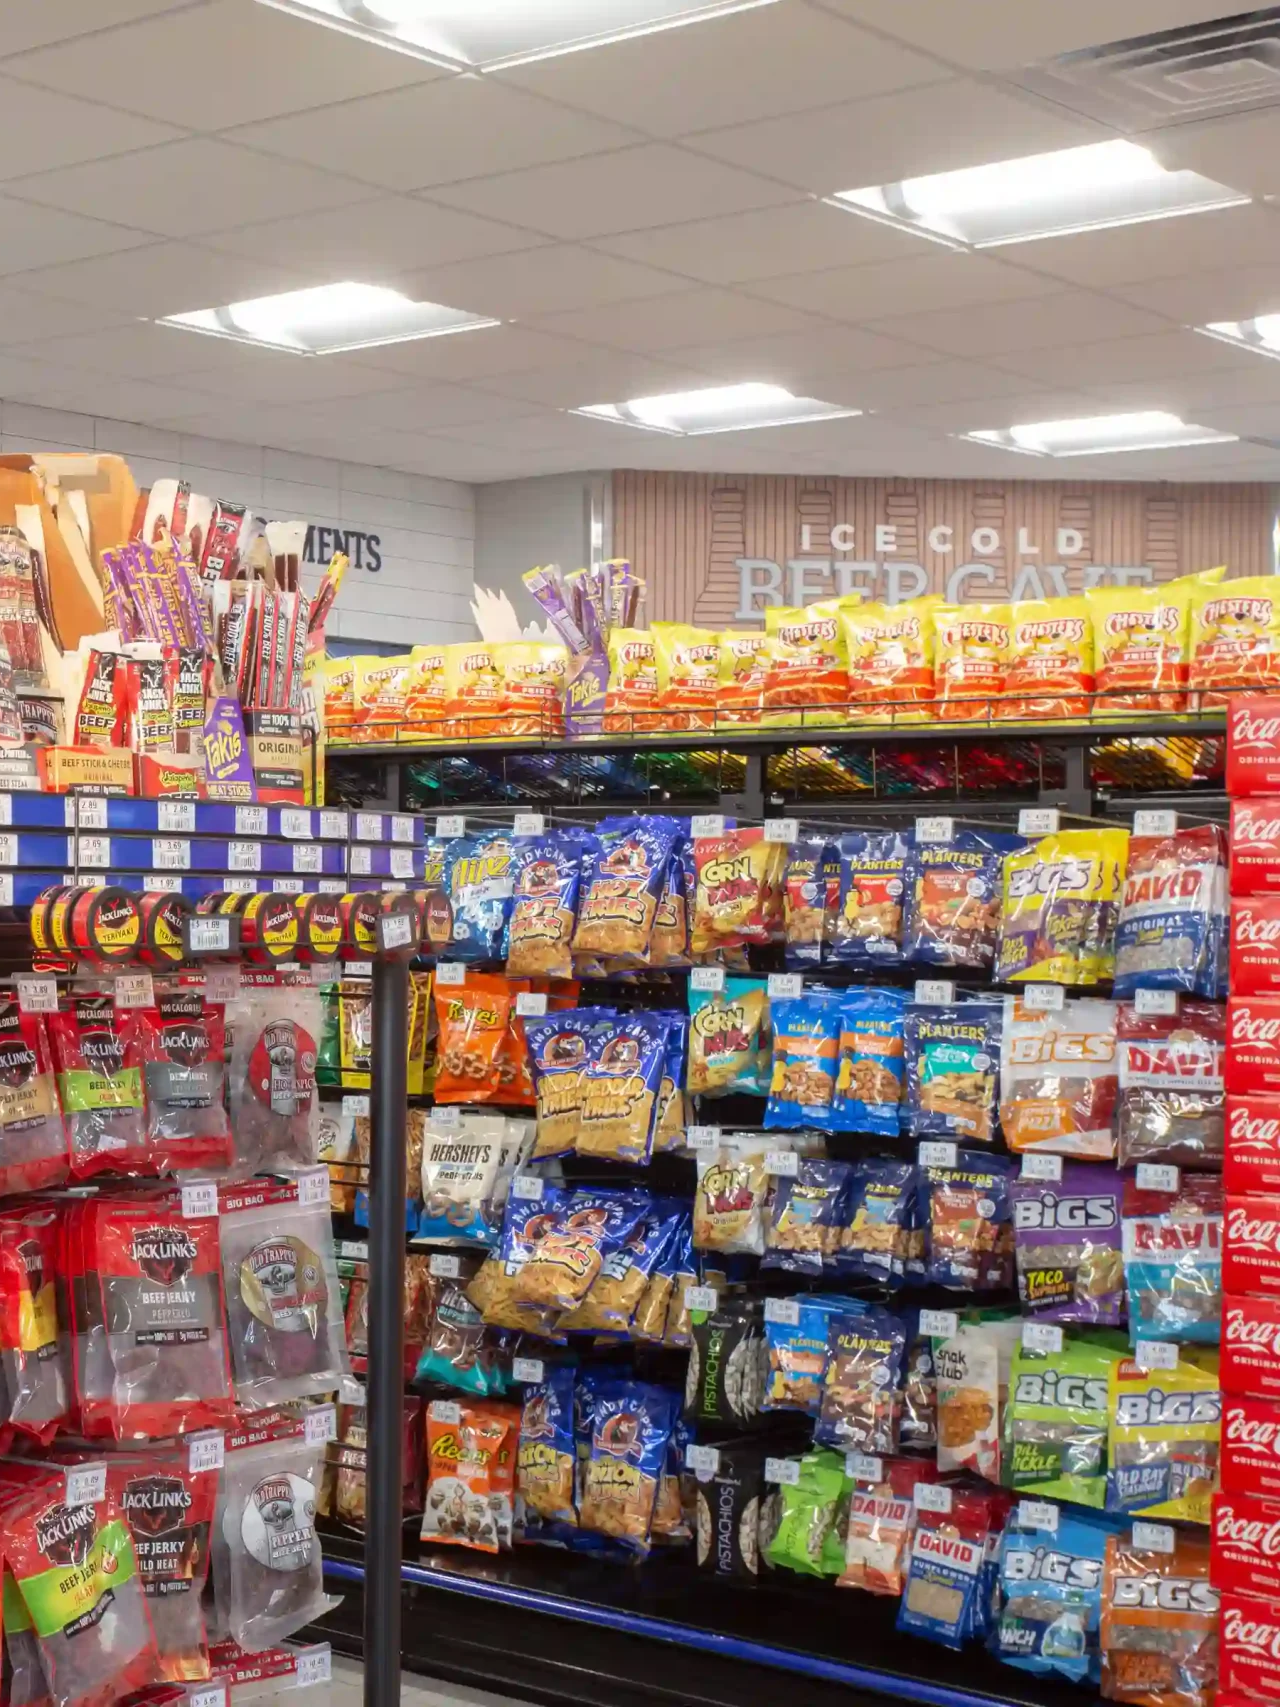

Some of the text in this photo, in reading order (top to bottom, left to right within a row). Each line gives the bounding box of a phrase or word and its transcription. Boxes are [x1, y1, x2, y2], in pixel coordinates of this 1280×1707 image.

[800, 524, 1084, 555] ICE COLD
[1201, 598, 1273, 627] CHESTER'S
[79, 716, 115, 729] BEEF
[204, 729, 242, 774] Takis
[258, 742, 303, 755] ORIGINAL
[851, 859, 903, 871] PLANTERS
[922, 851, 983, 867] PLANTERS
[701, 857, 750, 886] CORN
[1125, 869, 1203, 908] DAVID
[1124, 917, 1183, 931] ORIGINAL
[255, 974, 274, 983] BAG
[33, 986, 48, 994] 3.89
[76, 1009, 114, 1020] 100 CALORIES
[161, 1004, 172, 1012] 100
[693, 1005, 745, 1037] CORN
[160, 1034, 210, 1048] JACK LINK'S
[919, 1025, 985, 1040] PLANTERS
[7, 1050, 36, 1067] LINK'S
[429, 1144, 492, 1164] HERSHEY'S
[226, 1194, 264, 1209] BIG BAG
[1015, 1194, 1115, 1229] BiGS
[130, 1242, 198, 1260] JACK LINK'S
[1028, 1270, 1064, 1287] TACO
[142, 1291, 196, 1304] BEEF JERKY
[838, 1334, 891, 1354] PLANTERS
[938, 1349, 966, 1365] snak
[704, 1328, 724, 1413] PISTACHIOS
[936, 1363, 963, 1380] club
[1016, 1370, 1108, 1410] BiGS
[1117, 1389, 1223, 1427] BiGS
[232, 1431, 268, 1447] BIG BAG
[121, 1492, 192, 1509] JACK LINK'S
[853, 1495, 906, 1521] DAVID
[38, 1504, 96, 1552] JACK LINK'S
[135, 1541, 185, 1555] EEF JERKY
[919, 1531, 973, 1563] DAVID
[157, 1558, 178, 1569] HEAT
[1004, 1547, 1103, 1589] BiGS
[1113, 1571, 1221, 1613] BiGS
[236, 1668, 261, 1680] BAG
